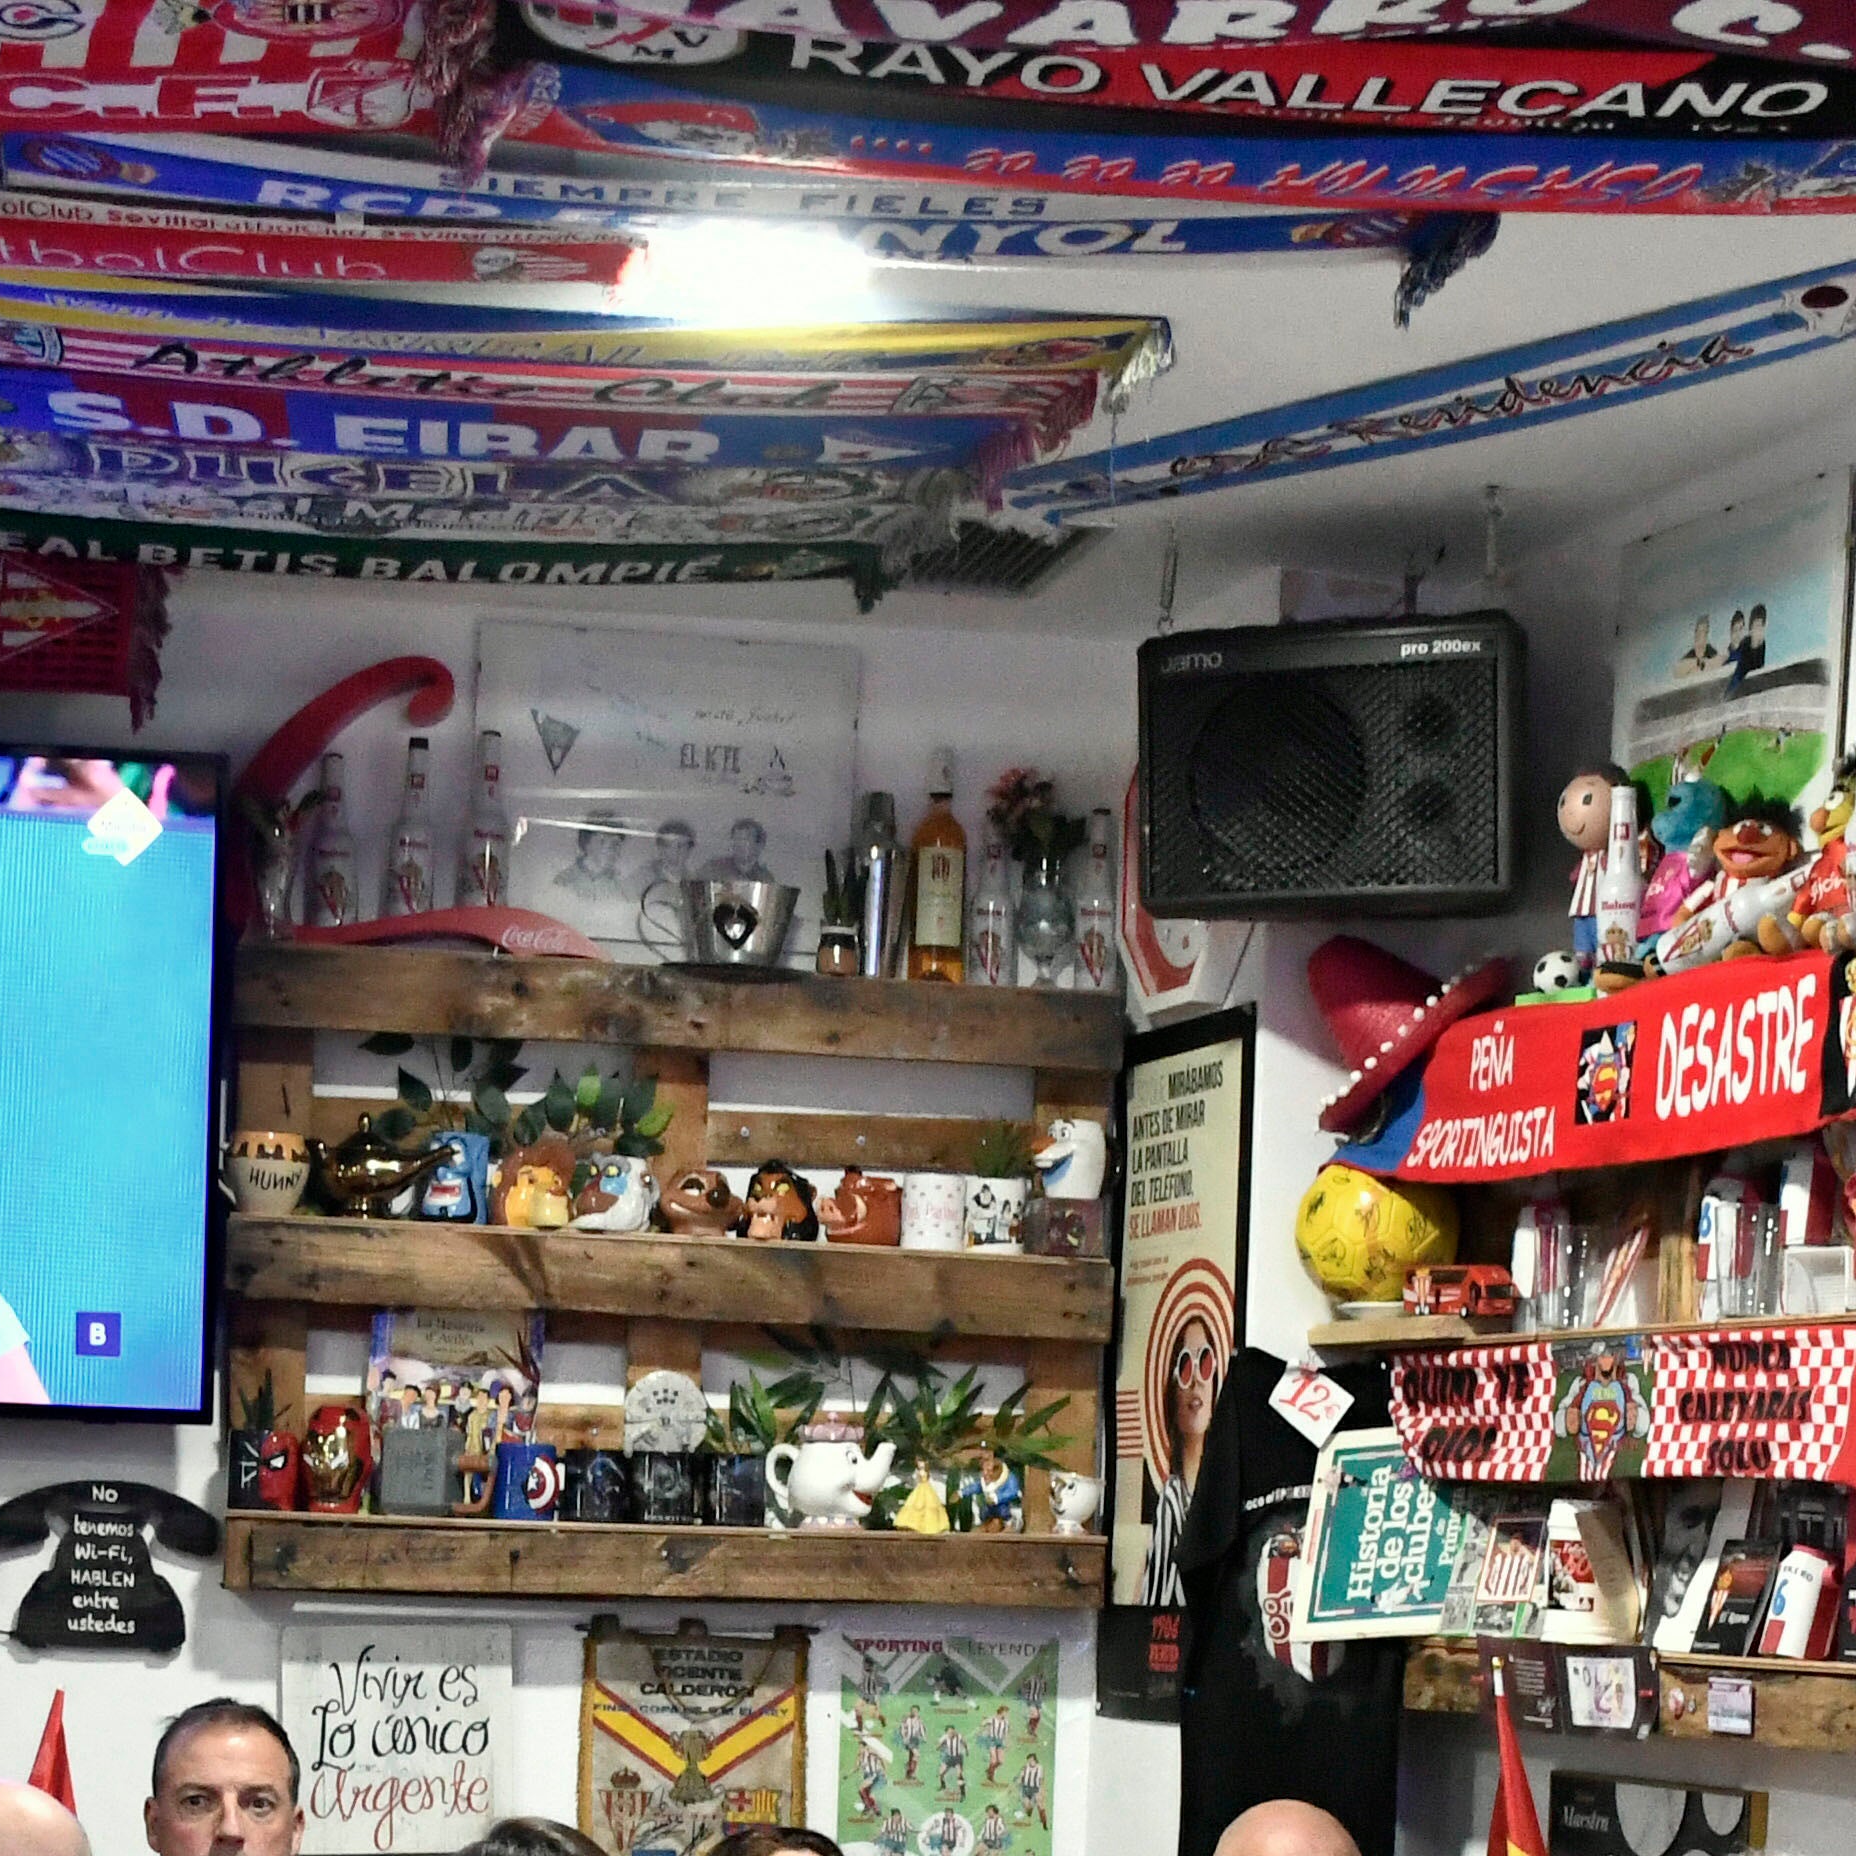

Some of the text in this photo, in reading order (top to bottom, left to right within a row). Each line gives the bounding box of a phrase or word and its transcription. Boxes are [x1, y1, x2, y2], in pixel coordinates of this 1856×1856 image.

[789, 34, 1829, 120] RAYO VALLECANO
[799, 192, 1049, 217] FIELES
[138, 543, 340, 576] BETIS
[360, 551, 724, 585] BALOMPIÉ
[1400, 638, 1482, 659] pro 200ex
[1470, 1019, 1516, 1091] PEÑA
[1655, 974, 1816, 1121] DESASTRE
[1132, 1099, 1206, 1142] ANTES DE MIRAR
[1406, 1105, 1557, 1169] SPORTINGUISTA
[248, 1165, 304, 1192] HUNNY
[1710, 1339, 1793, 1374] NUNCA
[91, 1483, 119, 1502] No
[73, 1513, 135, 1539] tenemos
[1346, 1463, 1394, 1602] Historia
[74, 1543, 134, 1565] Wi-Fi,
[70, 1569, 136, 1589] HABLEN
[72, 1593, 121, 1611] entre
[67, 1613, 136, 1636] ustedes
[653, 1646, 745, 1662] ESTADIO
[854, 1638, 944, 1654] SPORTING
[327, 1643, 480, 1717] Vivir es
[309, 1759, 491, 1852] Urgente
